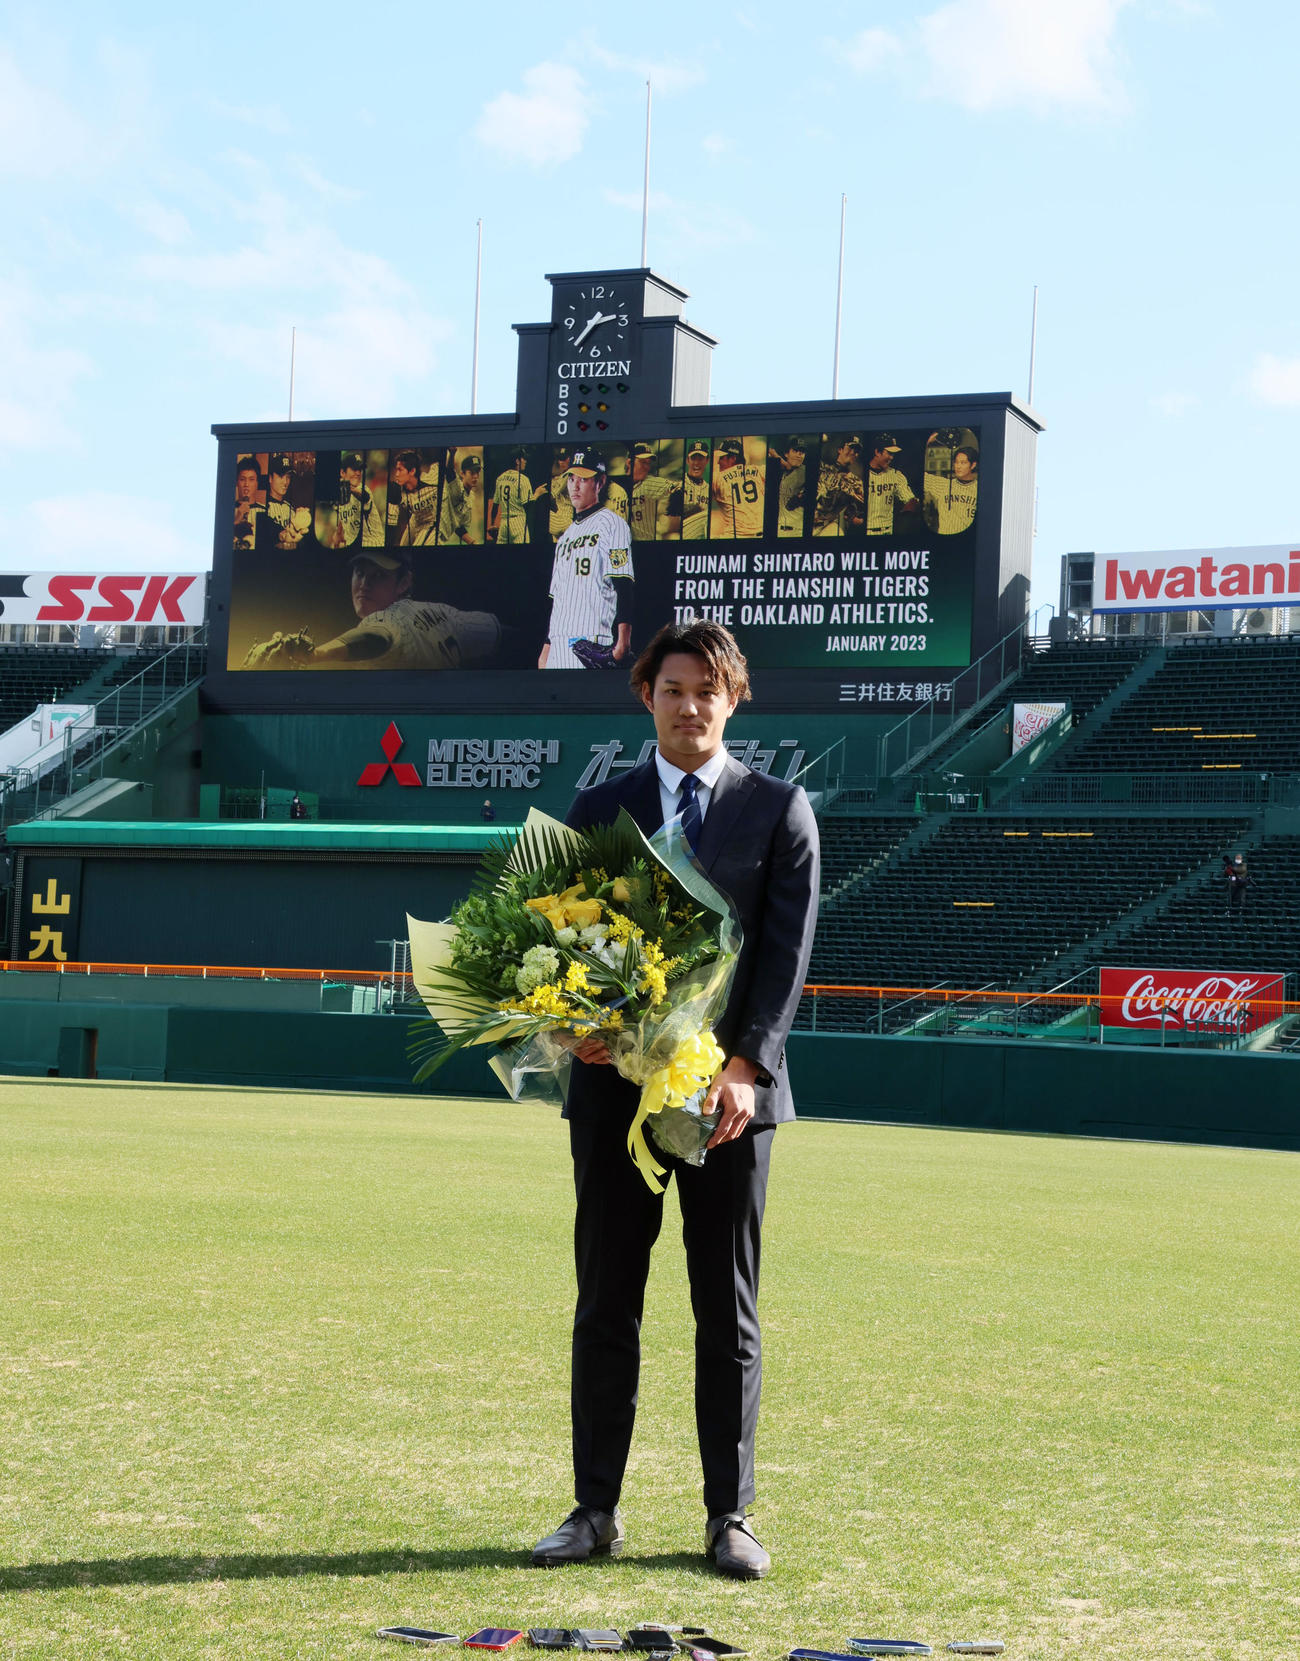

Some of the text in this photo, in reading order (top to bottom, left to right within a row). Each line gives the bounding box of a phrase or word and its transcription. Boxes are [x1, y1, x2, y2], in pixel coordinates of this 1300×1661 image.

[592, 286, 605, 299] 12
[564, 317, 575, 330] 9
[618, 314, 629, 327] 3
[590, 345, 601, 358] 6
[558, 360, 631, 379] CITIZEN
[558, 384, 569, 399] B
[558, 402, 568, 417] S
[557, 420, 567, 435] O
[731, 480, 758, 504] 19
[575, 557, 591, 576] 19
[676, 550, 930, 573] FUJINAMI SHINTARO WILL MOVE
[1104, 550, 1300, 601] Iwatani
[675, 576, 929, 600] FROM THE HANSHIN TIGERS
[36, 575, 197, 622] SSK
[674, 602, 934, 626] TO THE OAKLAND ATHLETICS.
[826, 634, 927, 652] JANUARY 2023
[839, 682, 953, 702] 三井住友銀行
[428, 739, 559, 764] MITSUBISHI
[427, 764, 541, 788] ELECTRIC
[29, 878, 71, 961] 山九
[1121, 974, 1260, 1026] Coca-Cola
